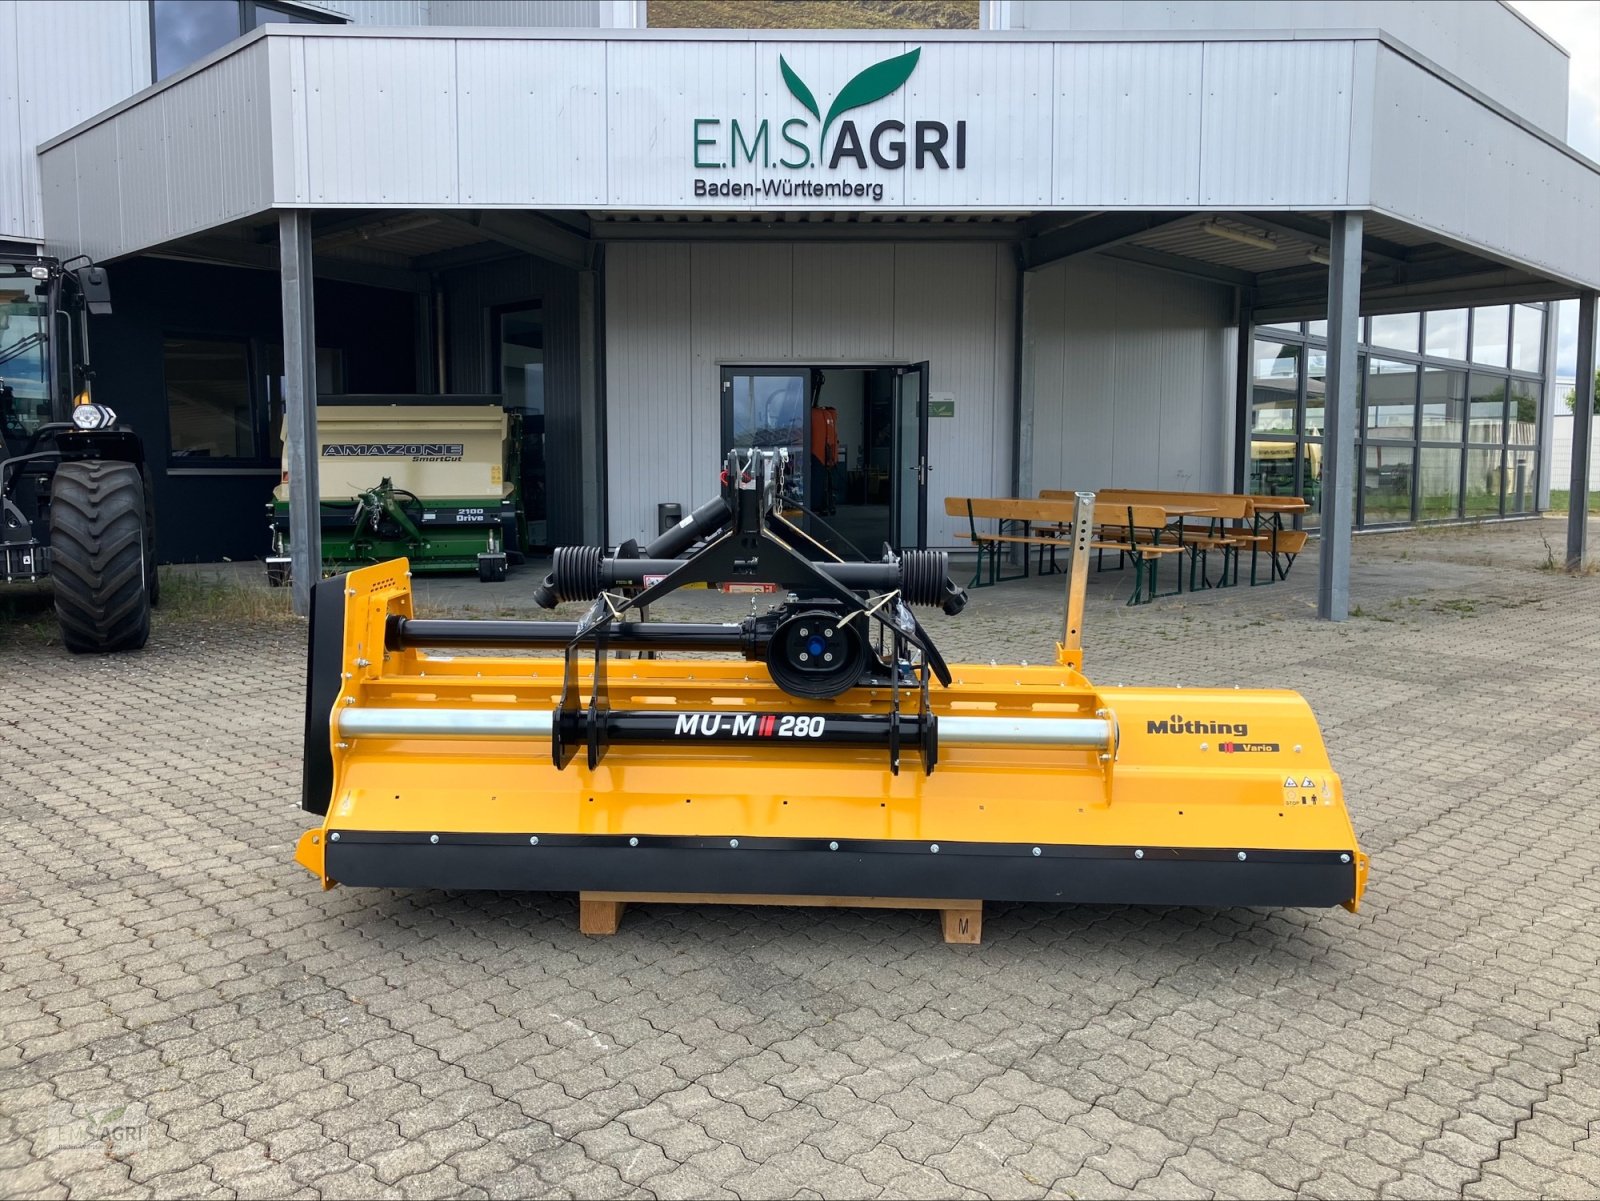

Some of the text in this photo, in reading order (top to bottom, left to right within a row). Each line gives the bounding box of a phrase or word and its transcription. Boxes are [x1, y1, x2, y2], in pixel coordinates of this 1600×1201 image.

[694, 119, 966, 169] E.M.S. AGRI
[694, 178, 883, 200] Baden-Württemberg
[323, 444, 462, 456] AMAZONE
[778, 715, 826, 737] 280
[1147, 714, 1248, 737] Müthing
[1242, 744, 1272, 752] Vario
[958, 917, 969, 935] M
